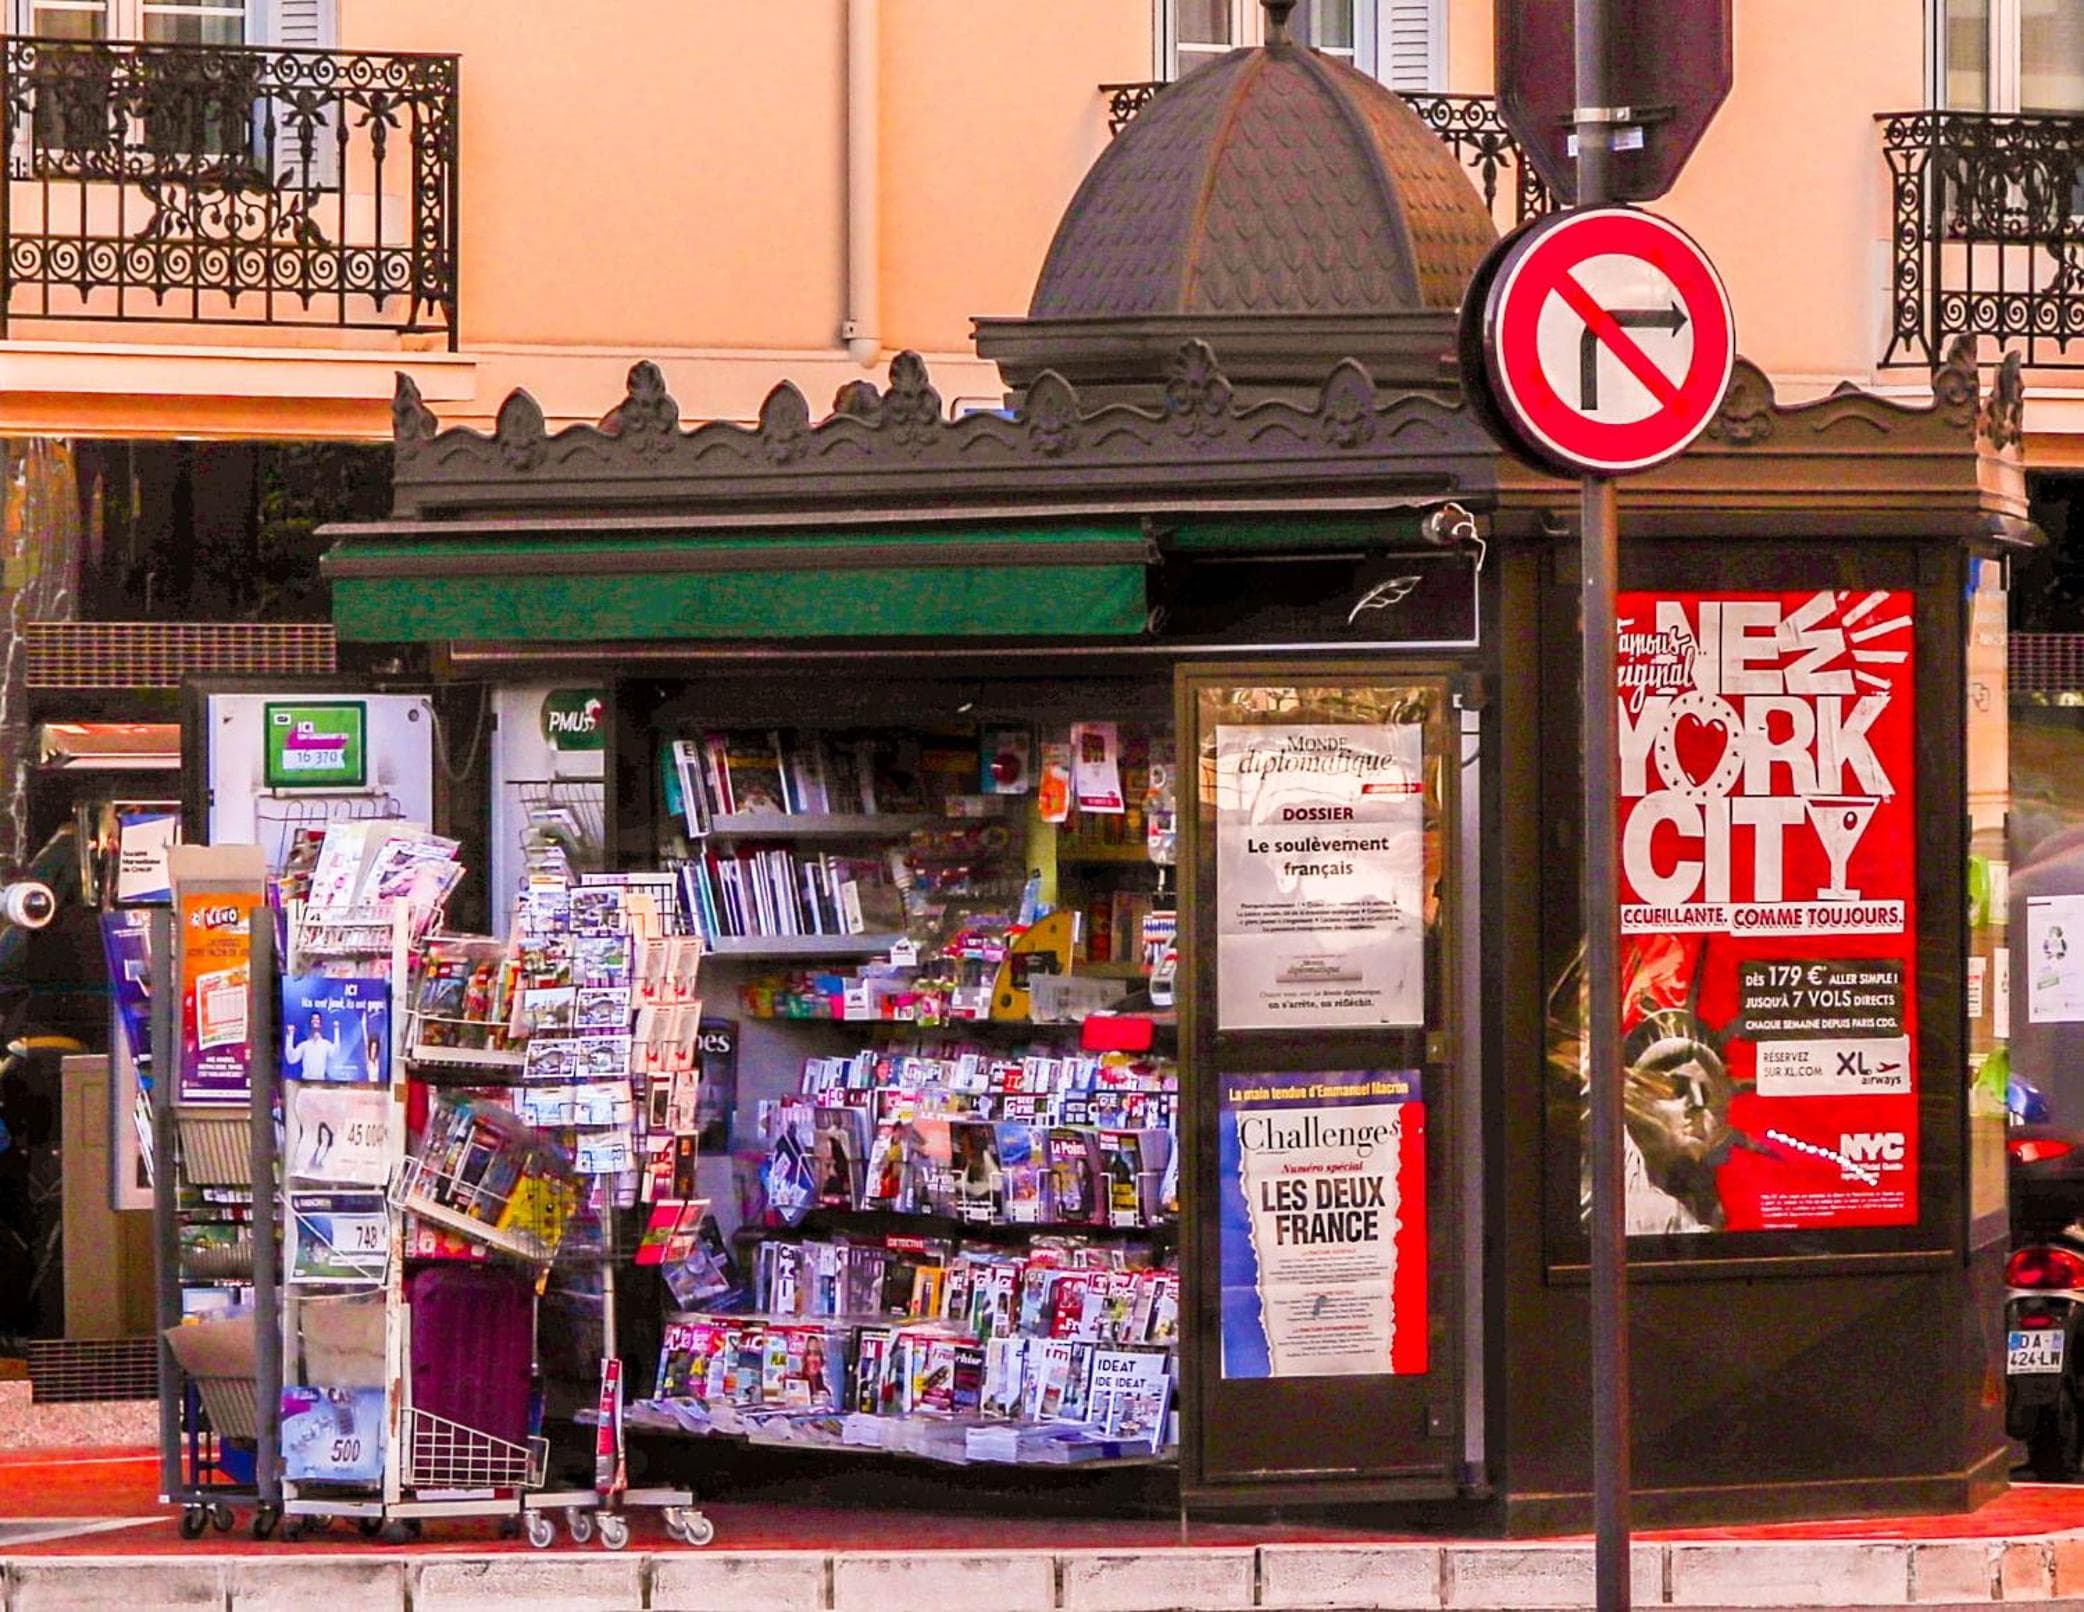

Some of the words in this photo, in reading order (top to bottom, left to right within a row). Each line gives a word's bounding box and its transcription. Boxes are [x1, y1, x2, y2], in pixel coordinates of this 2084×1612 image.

[1656, 590, 1856, 694] NEW
[548, 711, 585, 732] PMU
[1287, 736, 1350, 752] MONDE
[1617, 690, 1896, 798] YORK
[1238, 749, 1393, 780] diplomatique
[1282, 807, 1354, 821] DOSSIER
[1247, 839, 1270, 853] Le
[1274, 837, 1390, 853] soulèvement
[1623, 790, 1880, 903] CITY
[1283, 861, 1354, 878] français
[1623, 907, 1729, 925] CCUEILLANTE.
[1733, 908, 1803, 927] COMME
[1807, 906, 1904, 926] TOUJOURS.
[1745, 971, 1765, 987] DÈS
[1768, 965, 1802, 987] 179
[1829, 973, 1857, 985] ALLER
[1859, 972, 1894, 985] SIMPLE
[1792, 991, 1804, 1008] 7
[1808, 990, 1852, 1008] VOLS
[1853, 995, 1895, 1007] DIRECTS
[1745, 1019, 1782, 1031] CHAQUE
[1783, 1019, 1820, 1030] SEMAINE
[1821, 1018, 1850, 1029] DEPUIS
[1851, 1017, 1875, 1028] PARIS
[1763, 1050, 1809, 1063] RÉSERVEZ
[1836, 1051, 1869, 1076] XL
[1783, 1066, 1823, 1078] XL.COM
[1861, 1075, 1902, 1087] airways
[1241, 1115, 1401, 1158] Challenges
[1840, 1132, 1906, 1161] NYC
[1281, 1162, 1324, 1175] Numéro
[1325, 1160, 1365, 1175] spécial
[1261, 1178, 1308, 1213] LES
[1315, 1176, 1386, 1210] DEUX
[1275, 1209, 1379, 1246] FRANCE
[1097, 1359, 1137, 1373] IDEAT
[1115, 1377, 1147, 1389] IDEAT
[330, 1438, 361, 1463] 500
